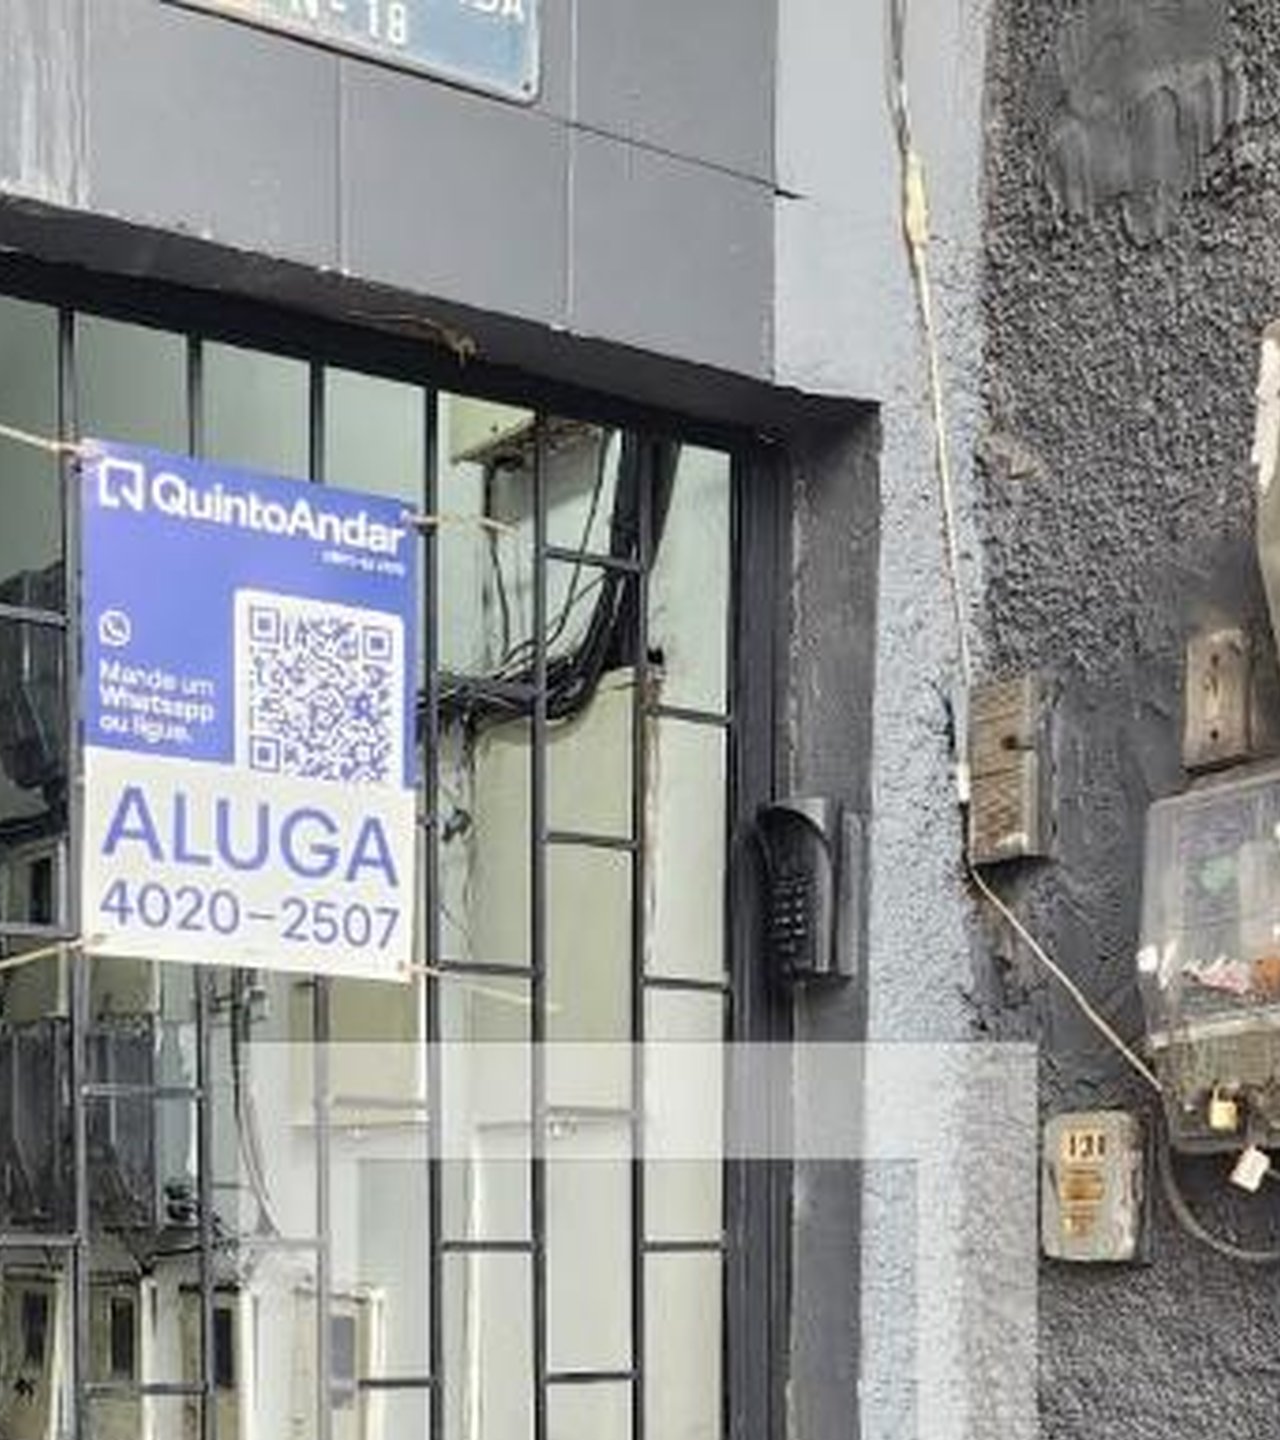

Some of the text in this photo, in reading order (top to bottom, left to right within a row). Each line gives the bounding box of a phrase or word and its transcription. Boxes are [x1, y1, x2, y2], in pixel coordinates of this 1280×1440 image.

[150, 471, 406, 556] QuintoAndar
[99, 659, 215, 697] Mande um
[99, 686, 214, 724] Whatsapp
[99, 716, 129, 733] ou
[101, 785, 399, 889] ALUGA
[99, 878, 401, 950] 4020-2507
